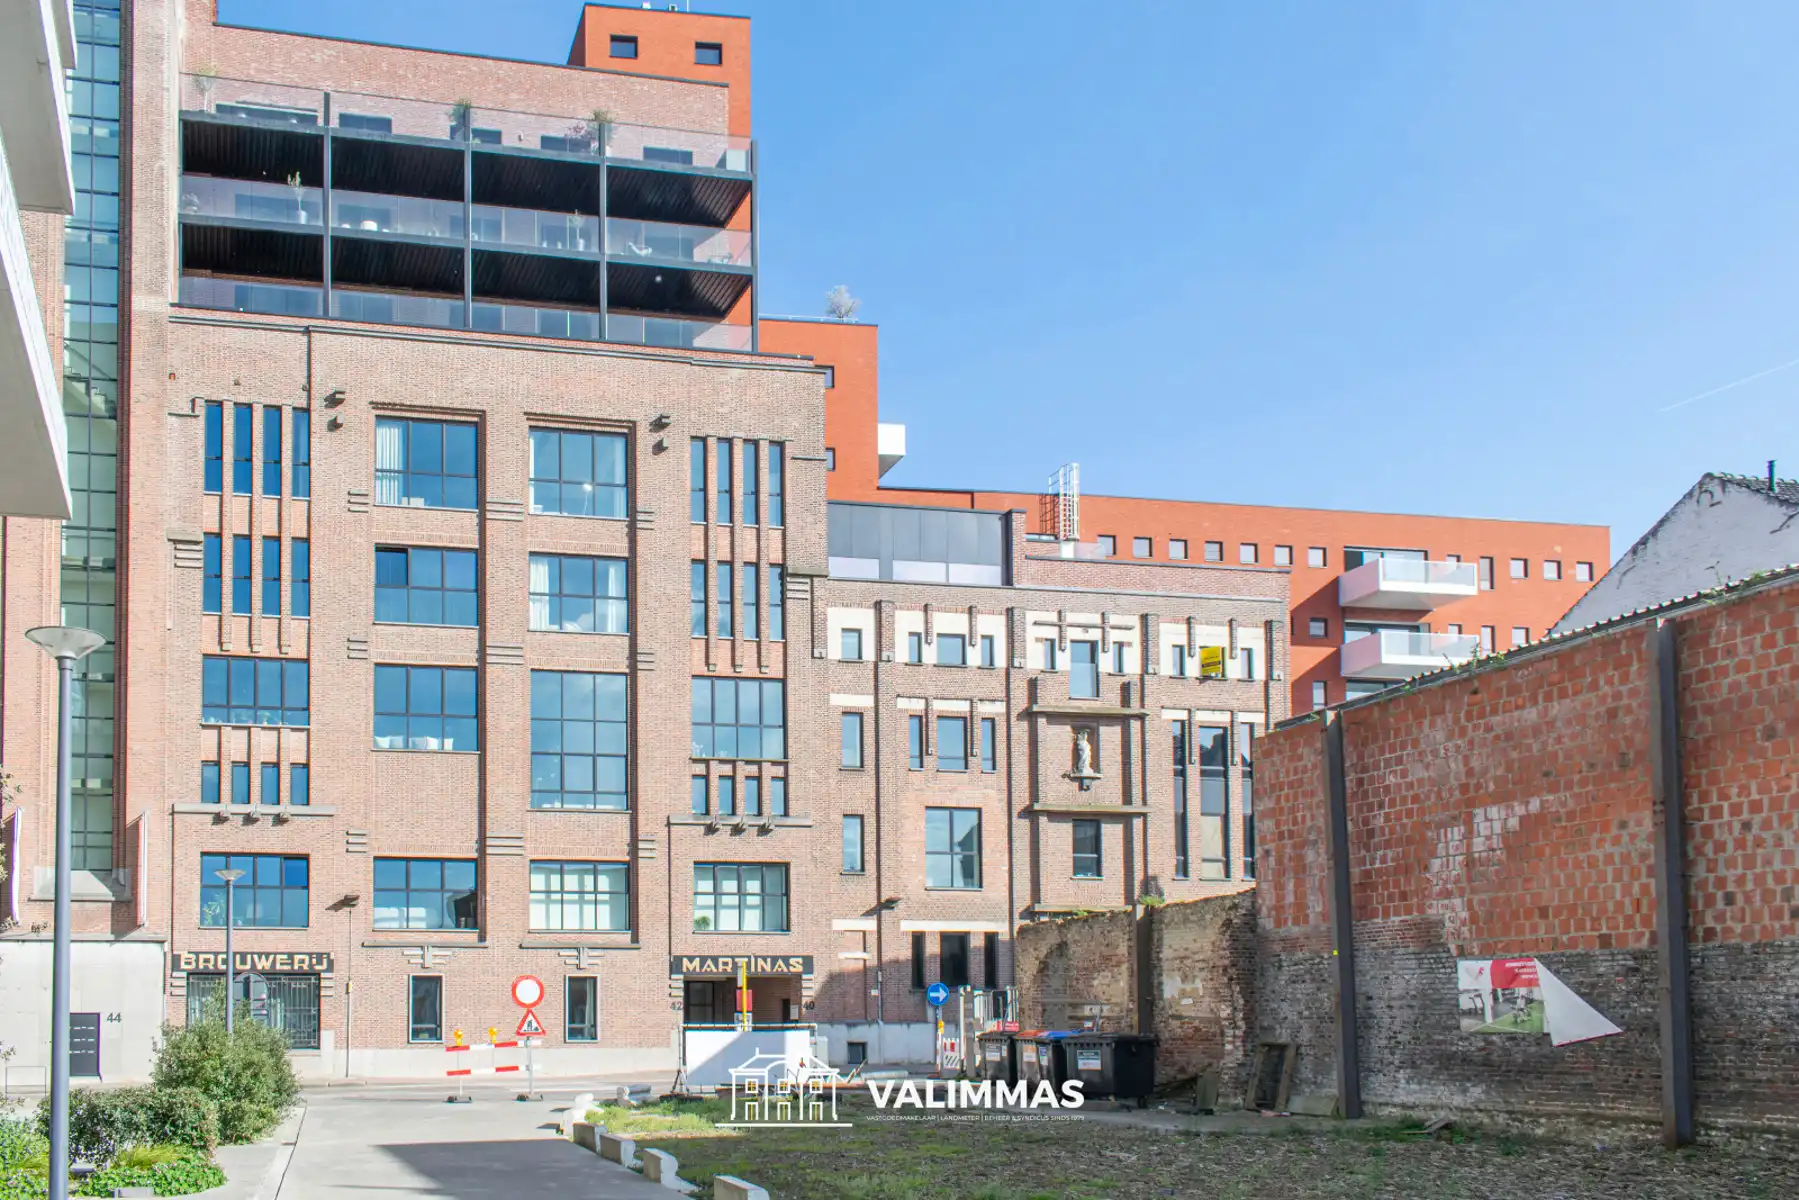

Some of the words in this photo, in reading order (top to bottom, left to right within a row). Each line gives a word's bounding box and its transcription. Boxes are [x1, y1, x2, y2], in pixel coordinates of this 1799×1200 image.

[681, 957, 804, 973] MARTINAS
[670, 1001, 683, 1011] 42
[803, 1000, 815, 1010] 40
[106, 1012, 122, 1023] 44
